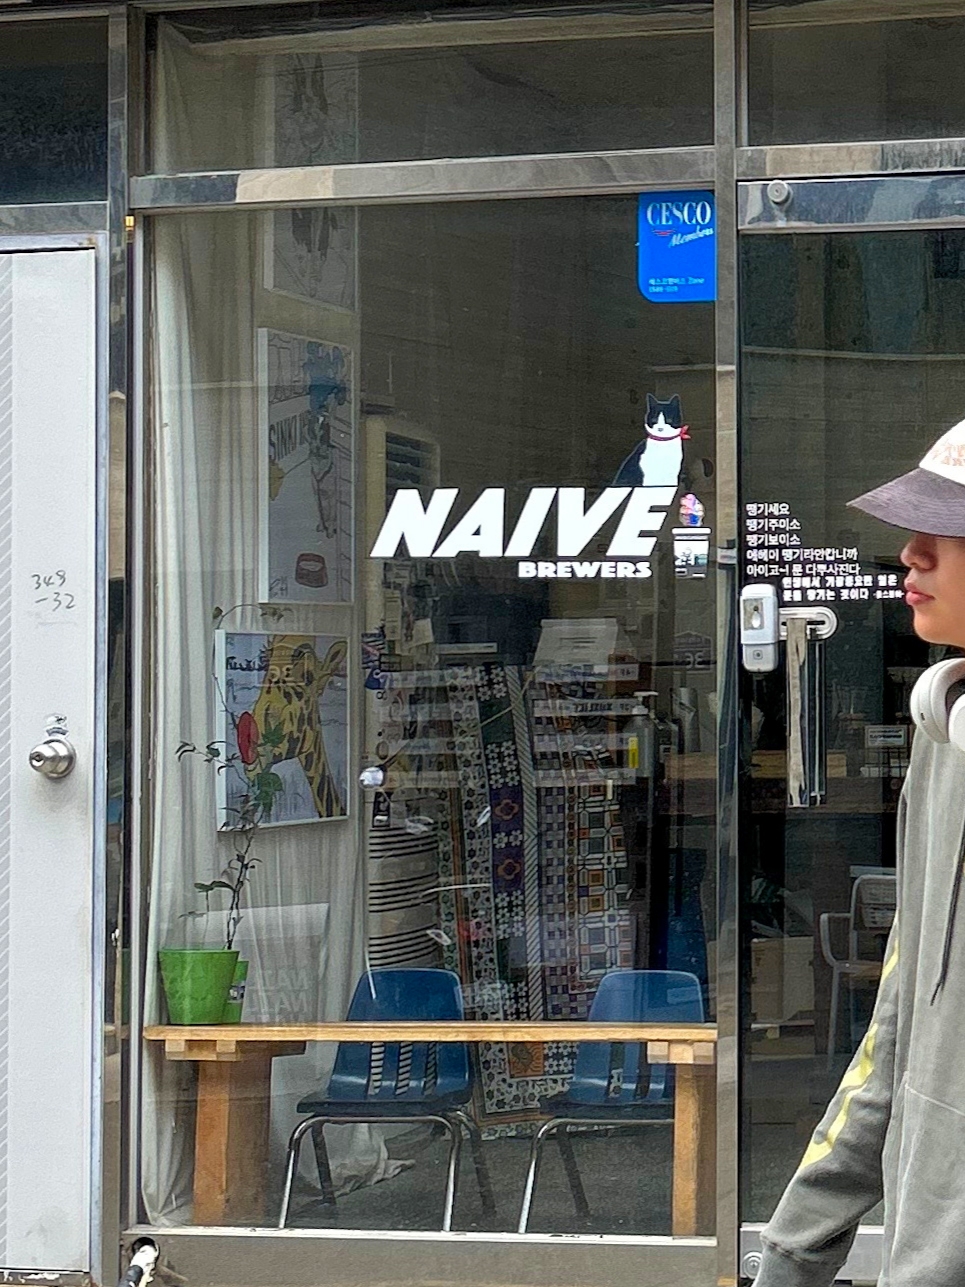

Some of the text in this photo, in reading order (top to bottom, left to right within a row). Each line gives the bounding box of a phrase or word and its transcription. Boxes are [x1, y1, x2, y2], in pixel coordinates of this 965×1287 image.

[646, 201, 712, 226] CESCO
[746, 503, 790, 516] 땡기세요
[370, 487, 678, 558] NAIVE
[746, 518, 801, 531] 땡기주이소
[746, 534, 801, 546] 땡기보이소
[518, 561, 652, 579] BREWERS
[792, 564, 804, 576] 문
